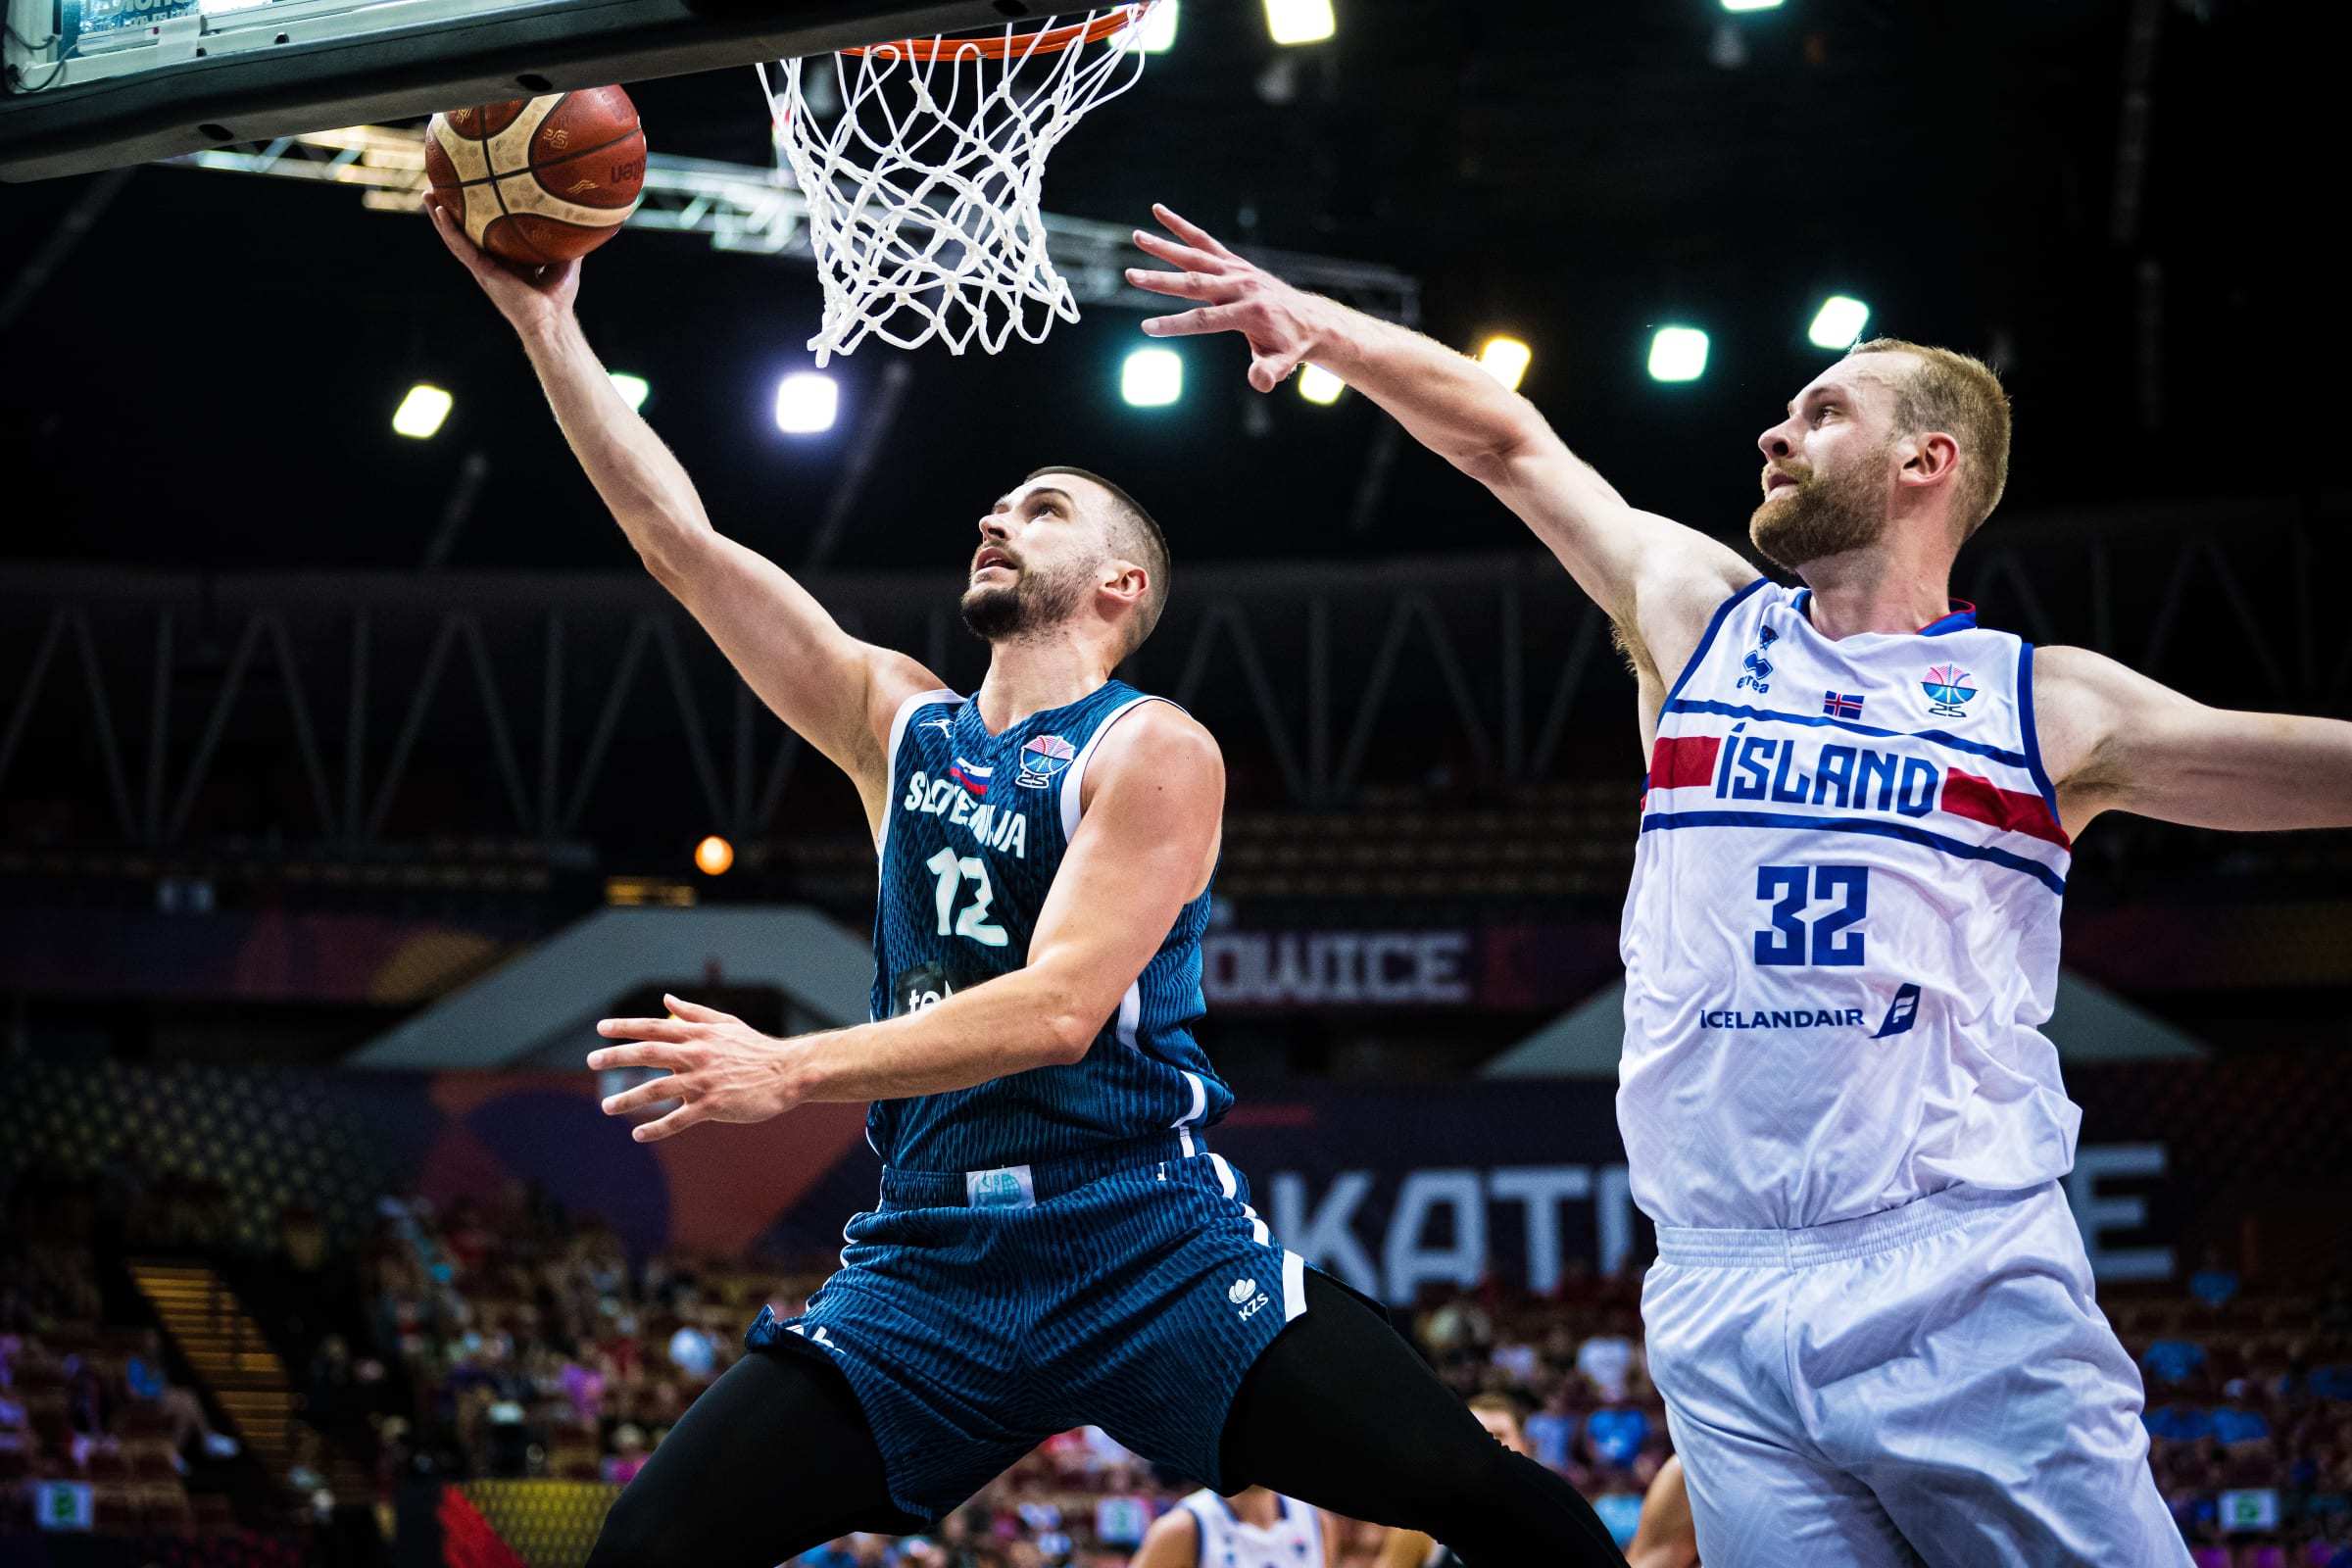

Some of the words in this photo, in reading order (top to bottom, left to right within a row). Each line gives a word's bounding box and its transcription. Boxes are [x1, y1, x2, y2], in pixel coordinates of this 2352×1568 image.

[1715, 722, 1939, 819] ÍSLAND
[926, 846, 1008, 947] 12
[1754, 865, 1870, 966] 32
[1700, 1008, 1865, 1029] ICELANDAIR
[1238, 1293, 1269, 1322] KZS
